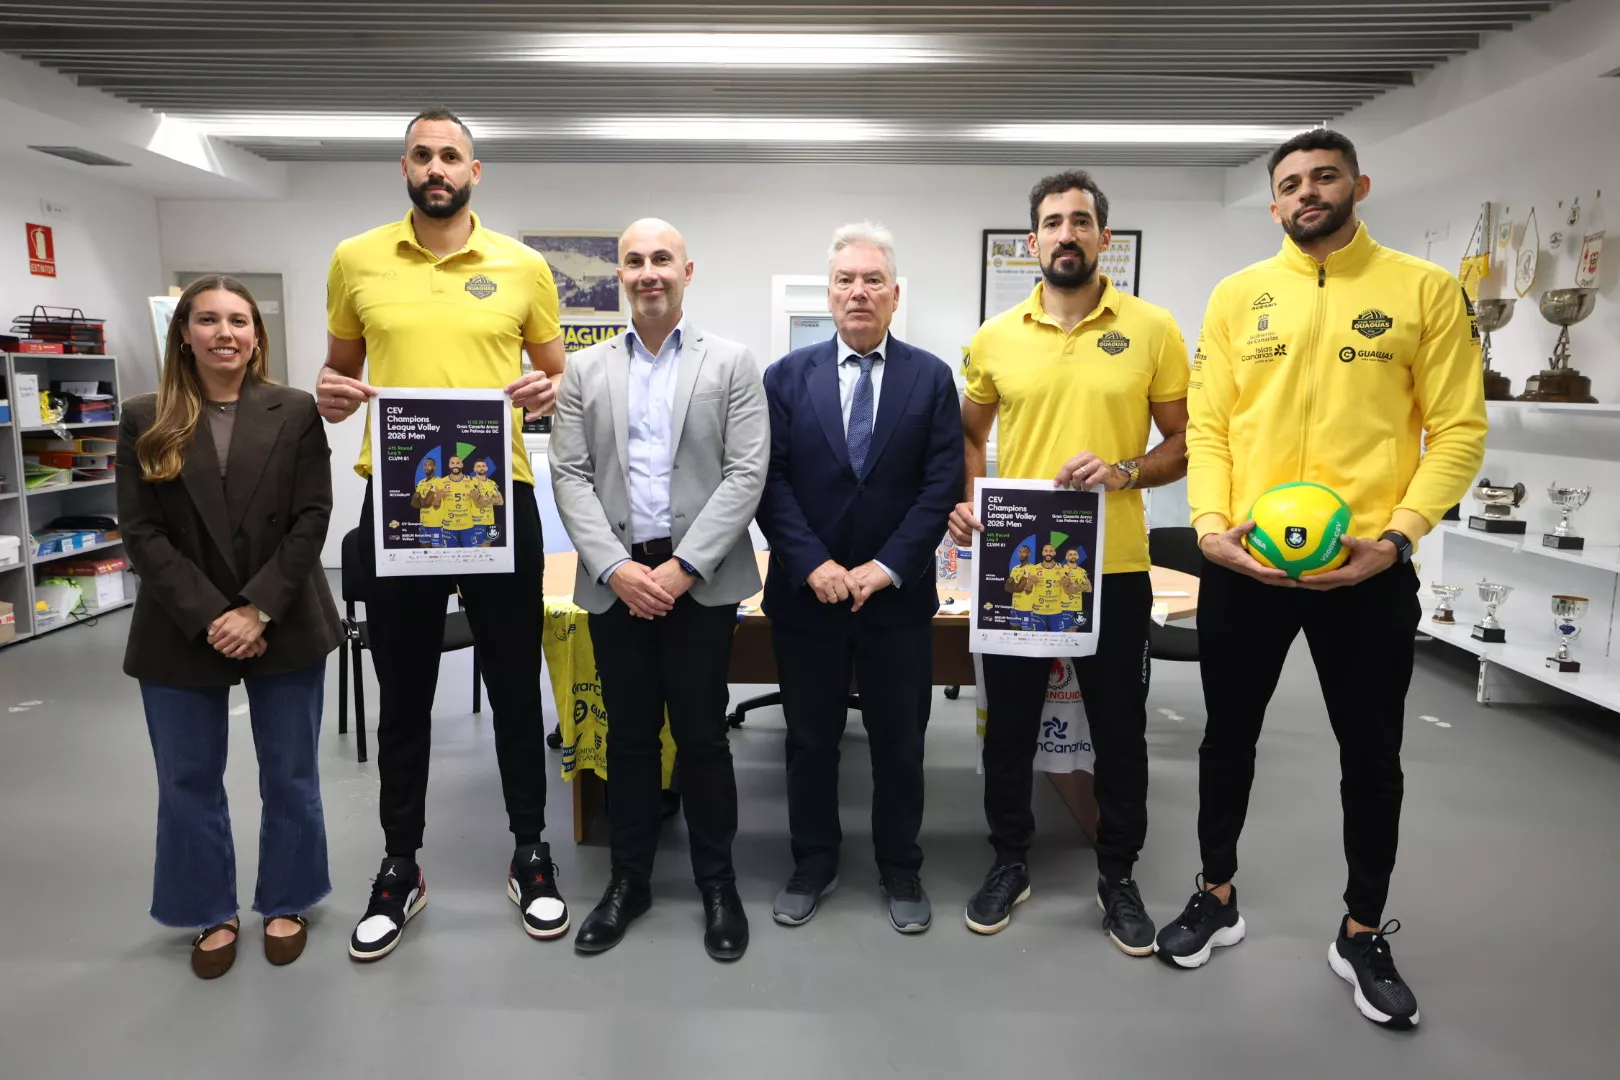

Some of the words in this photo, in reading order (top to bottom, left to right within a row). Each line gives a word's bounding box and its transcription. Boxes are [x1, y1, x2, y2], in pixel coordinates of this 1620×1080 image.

[31, 263, 54, 274] EXTINTOR
[1358, 350, 1394, 360] GUAGUAS
[387, 415, 430, 424] Champions
[387, 424, 416, 432] League
[418, 424, 440, 432] Volley
[988, 504, 1027, 513] Champions
[988, 512, 1013, 520] League
[1015, 512, 1037, 521] Volley
[1321, 521, 1342, 562] V200W-CEV
[590, 704, 608, 722] GUA
[1037, 740, 1091, 754] nCanaria
